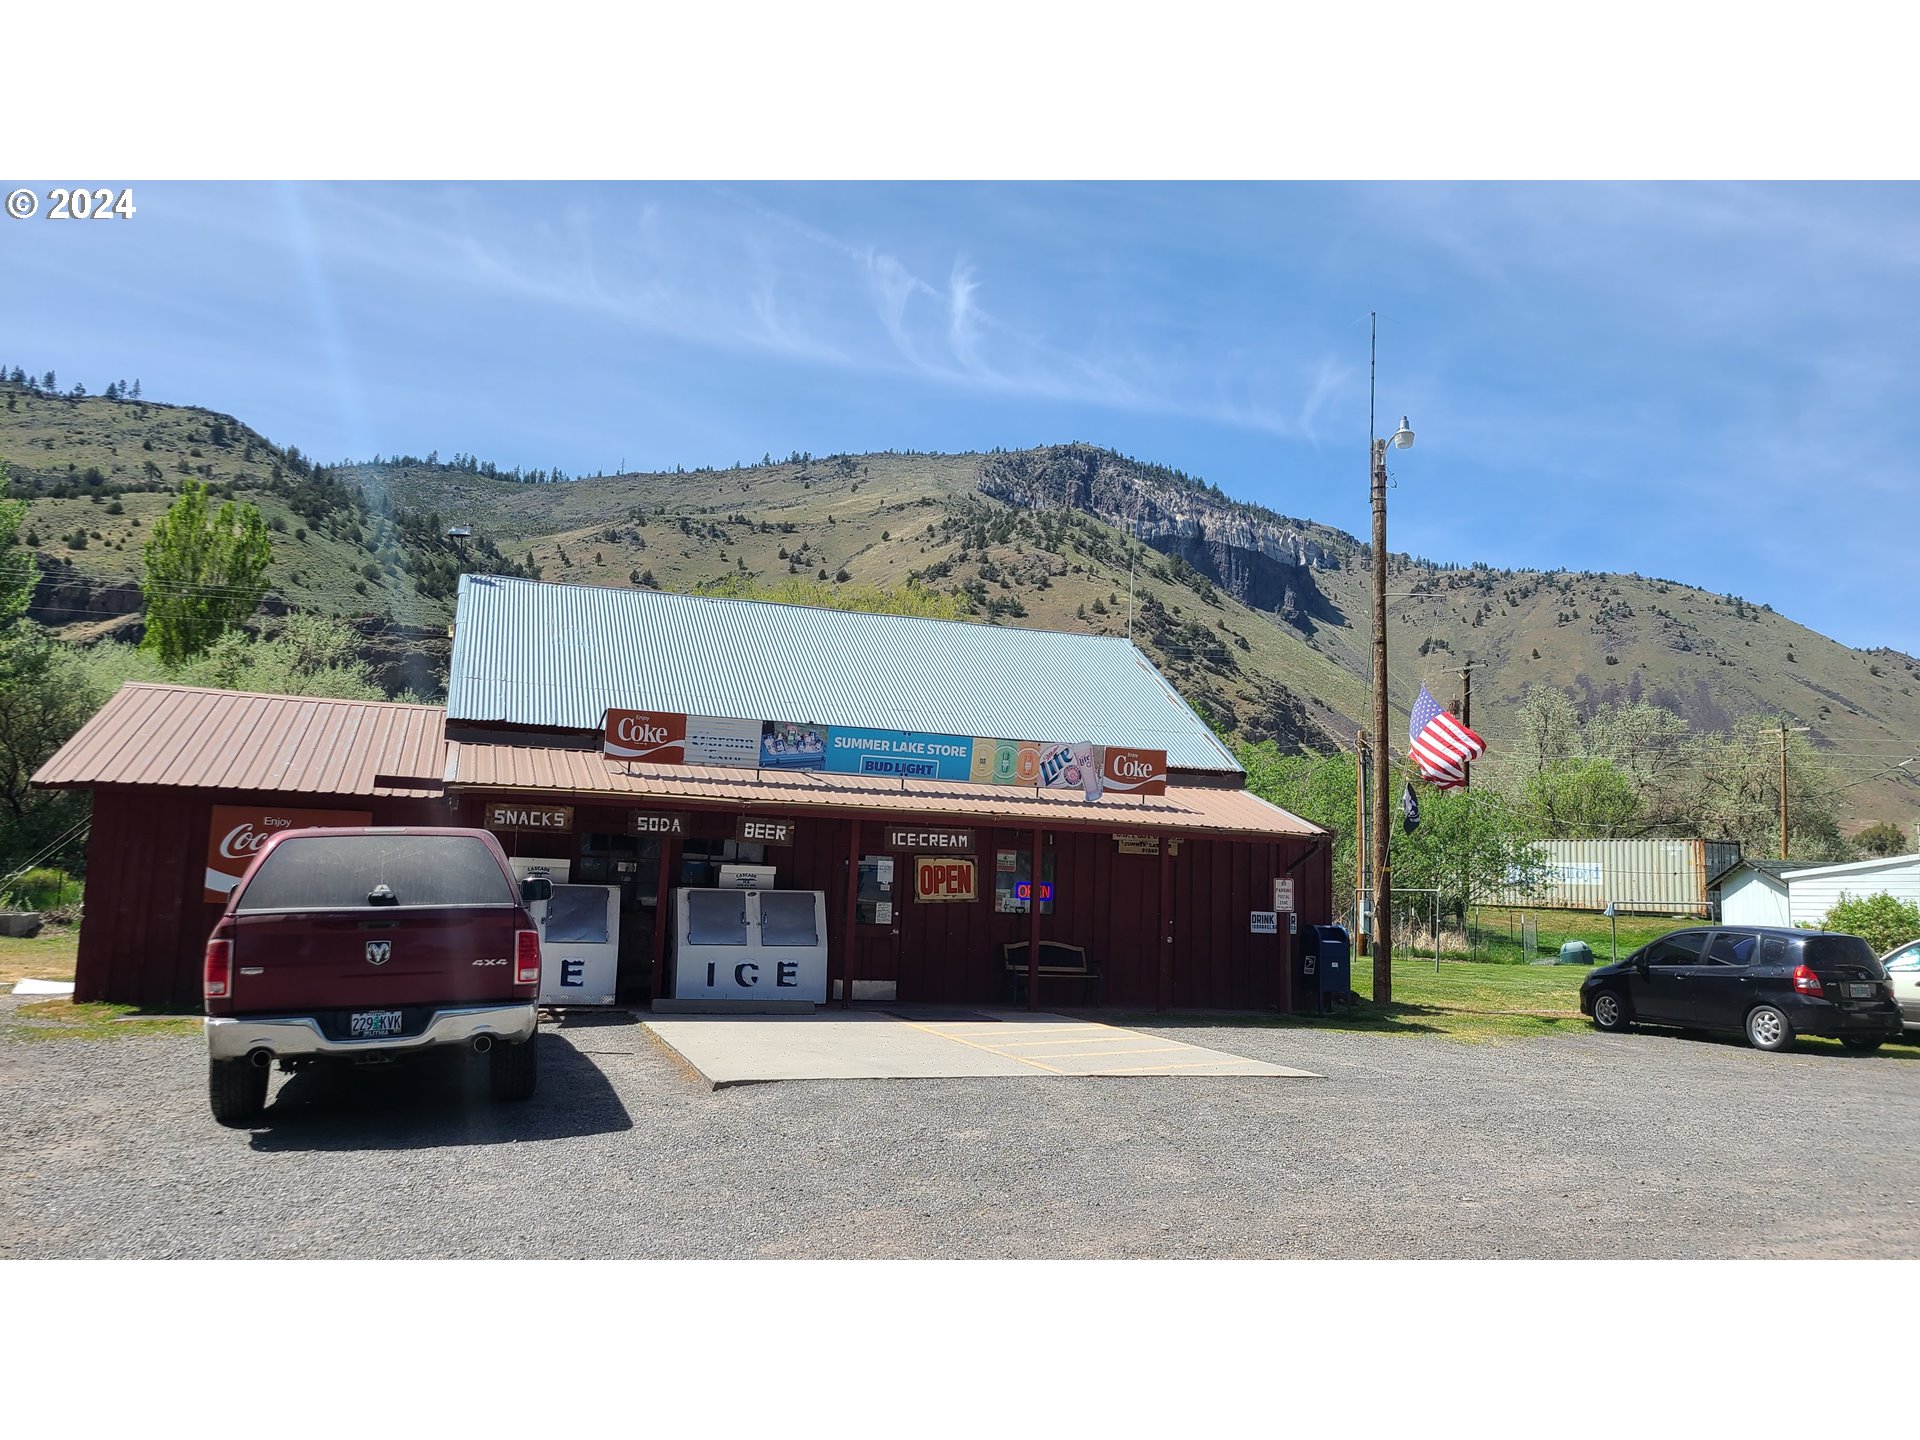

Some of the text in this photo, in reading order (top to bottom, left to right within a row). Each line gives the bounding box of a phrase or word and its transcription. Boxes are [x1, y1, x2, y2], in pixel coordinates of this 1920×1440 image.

[618, 718, 668, 744] Coke
[834, 737, 967, 757] SUMMER LAKE STORE
[865, 761, 934, 775] BUD LIGHT
[1040, 748, 1074, 786] Lite
[1113, 755, 1153, 778] Coke
[264, 816, 292, 827] Enjoy
[494, 809, 565, 826] SNACKS
[637, 816, 681, 832] SODA
[219, 823, 268, 858] Coc
[744, 822, 787, 840] BEER
[920, 865, 971, 895] OPEN
[1252, 914, 1275, 924] DRINK
[706, 958, 799, 987] ICE
[353, 1015, 401, 1031] 229 KVK
